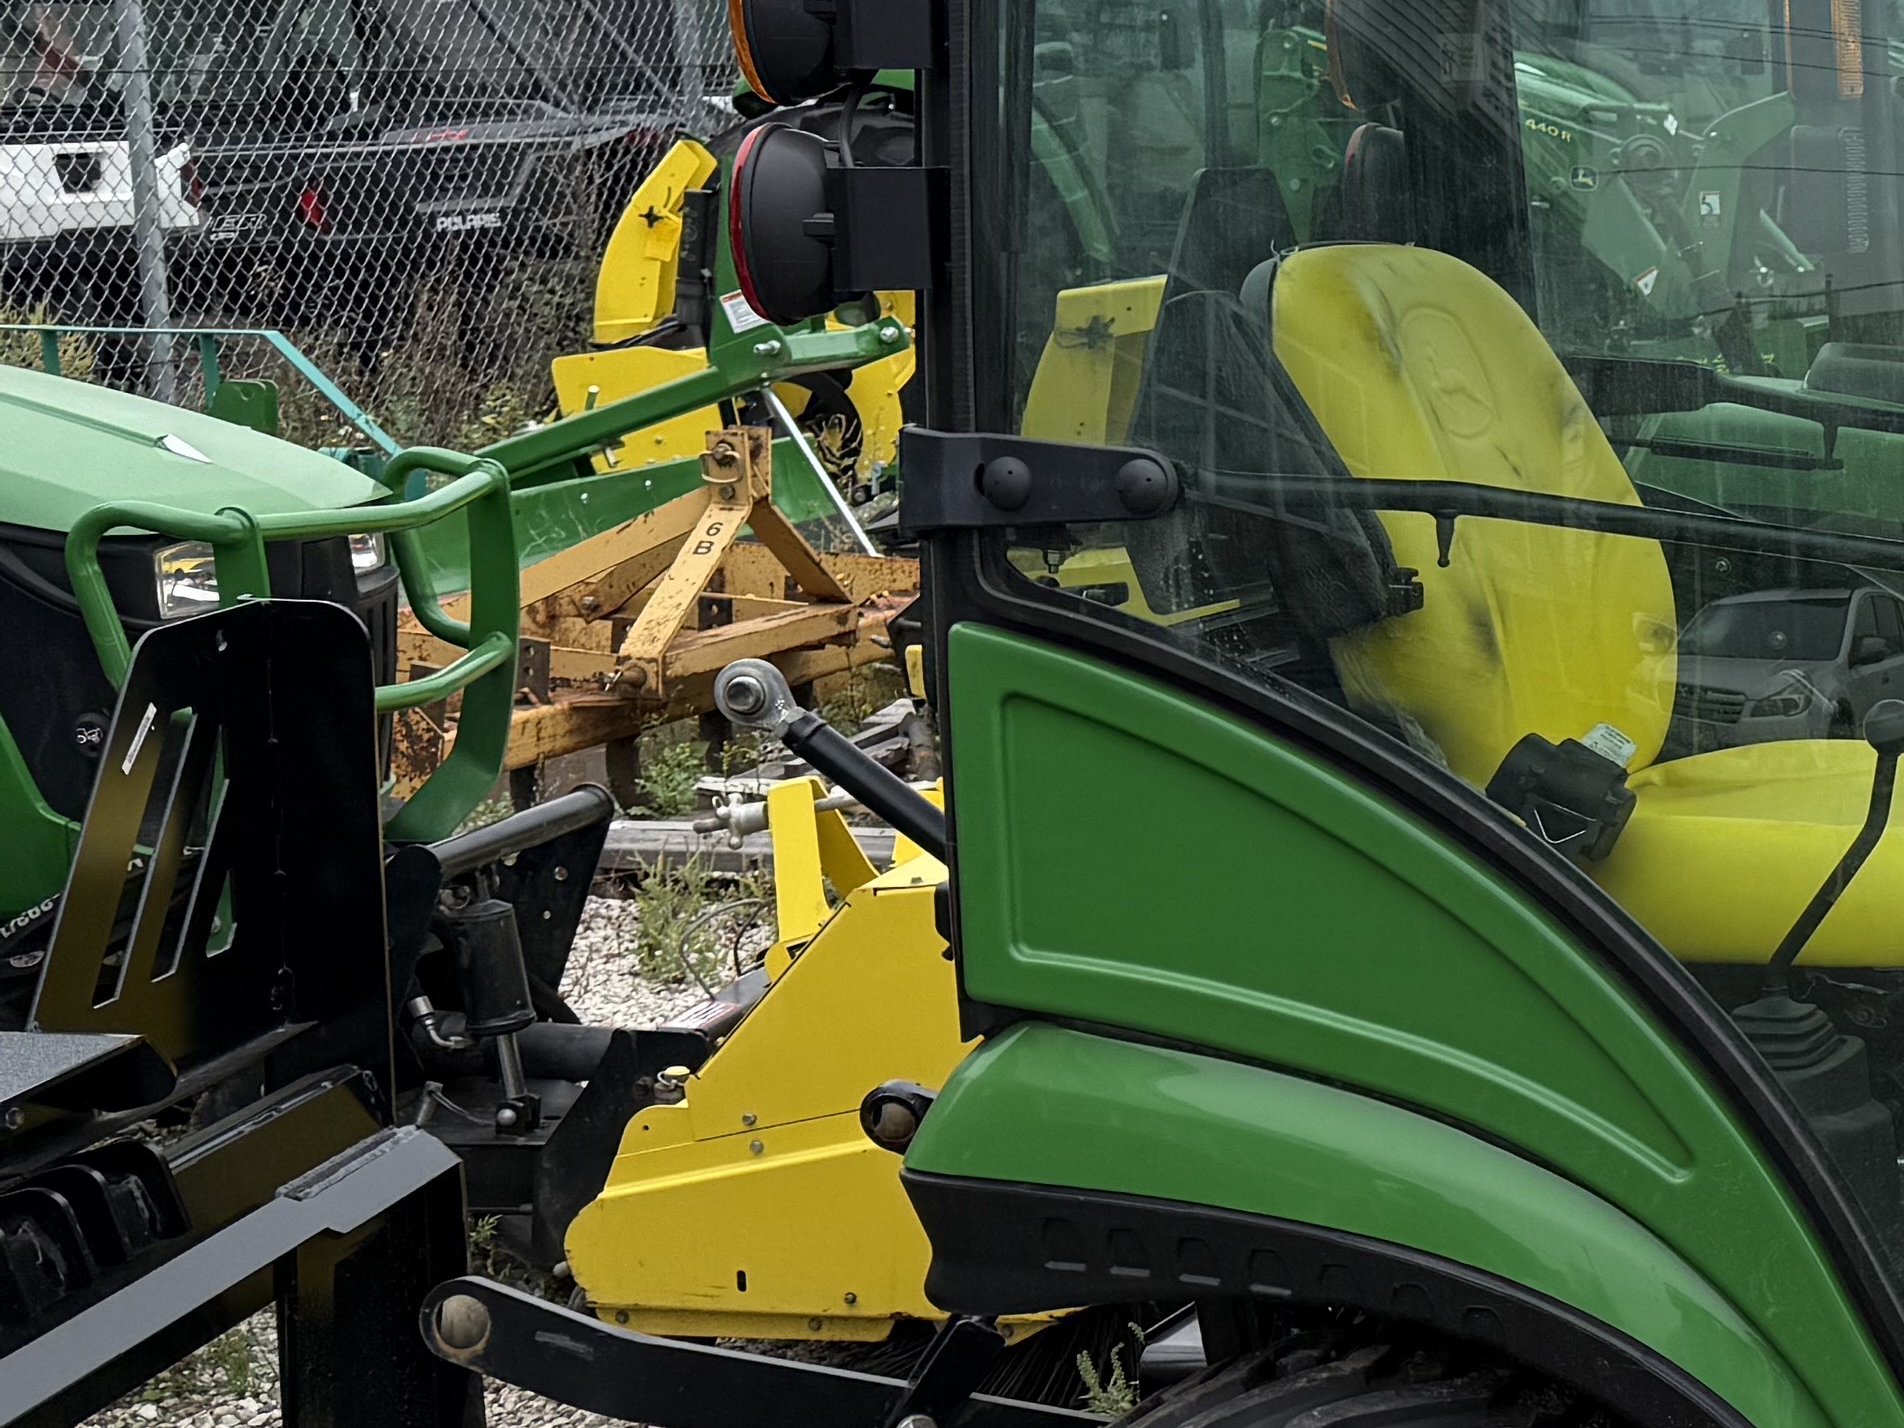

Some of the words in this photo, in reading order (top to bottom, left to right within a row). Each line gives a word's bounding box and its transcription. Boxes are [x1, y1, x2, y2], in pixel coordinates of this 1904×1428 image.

[436, 214, 501, 232] POLARIS
[706, 522, 723, 536] 6
[693, 541, 714, 554] B
